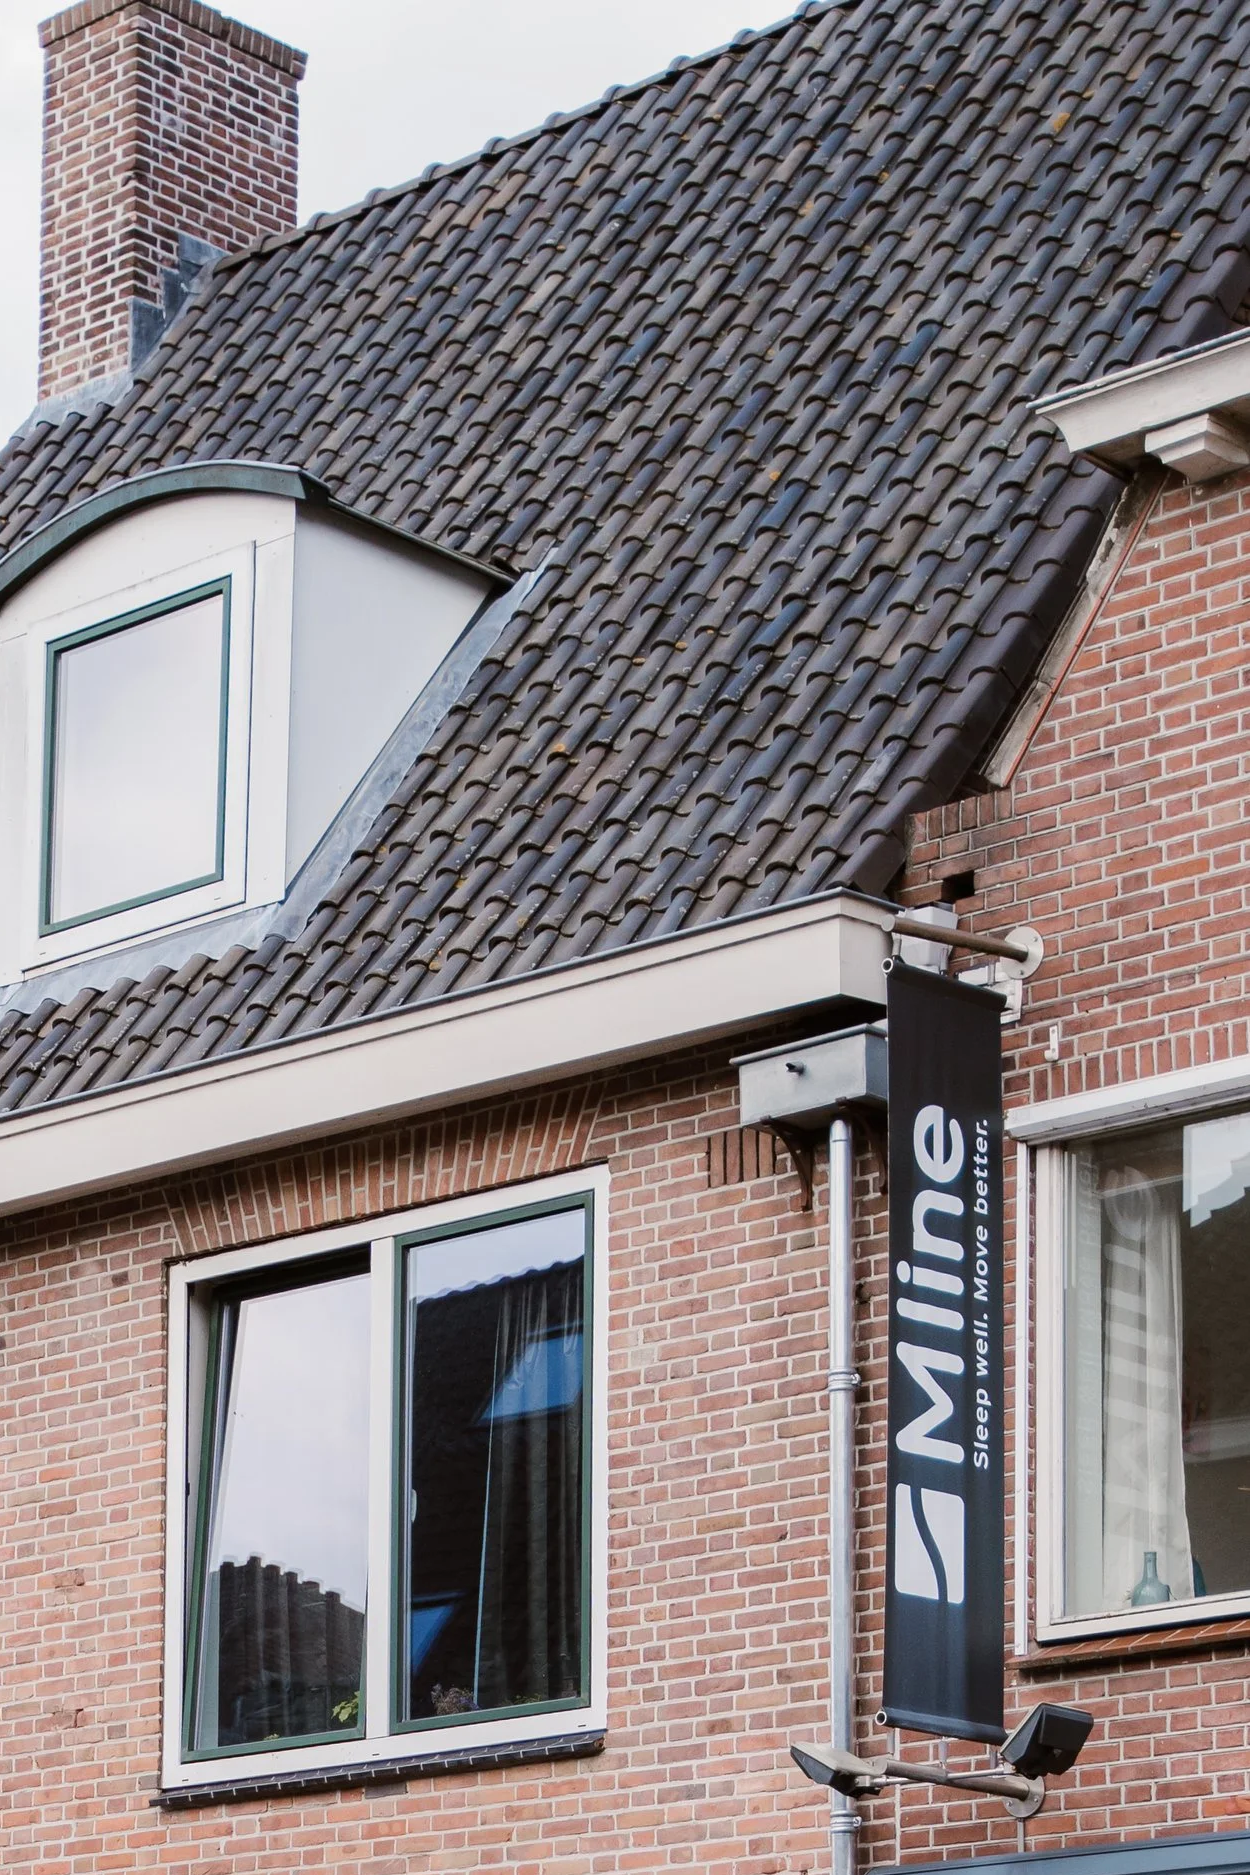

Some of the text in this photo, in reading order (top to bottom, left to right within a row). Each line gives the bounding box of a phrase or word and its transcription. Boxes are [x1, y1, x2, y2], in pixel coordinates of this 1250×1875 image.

[896, 1105, 965, 1464] Mline
[973, 1118, 991, 1470] Sleep well. Move better.
